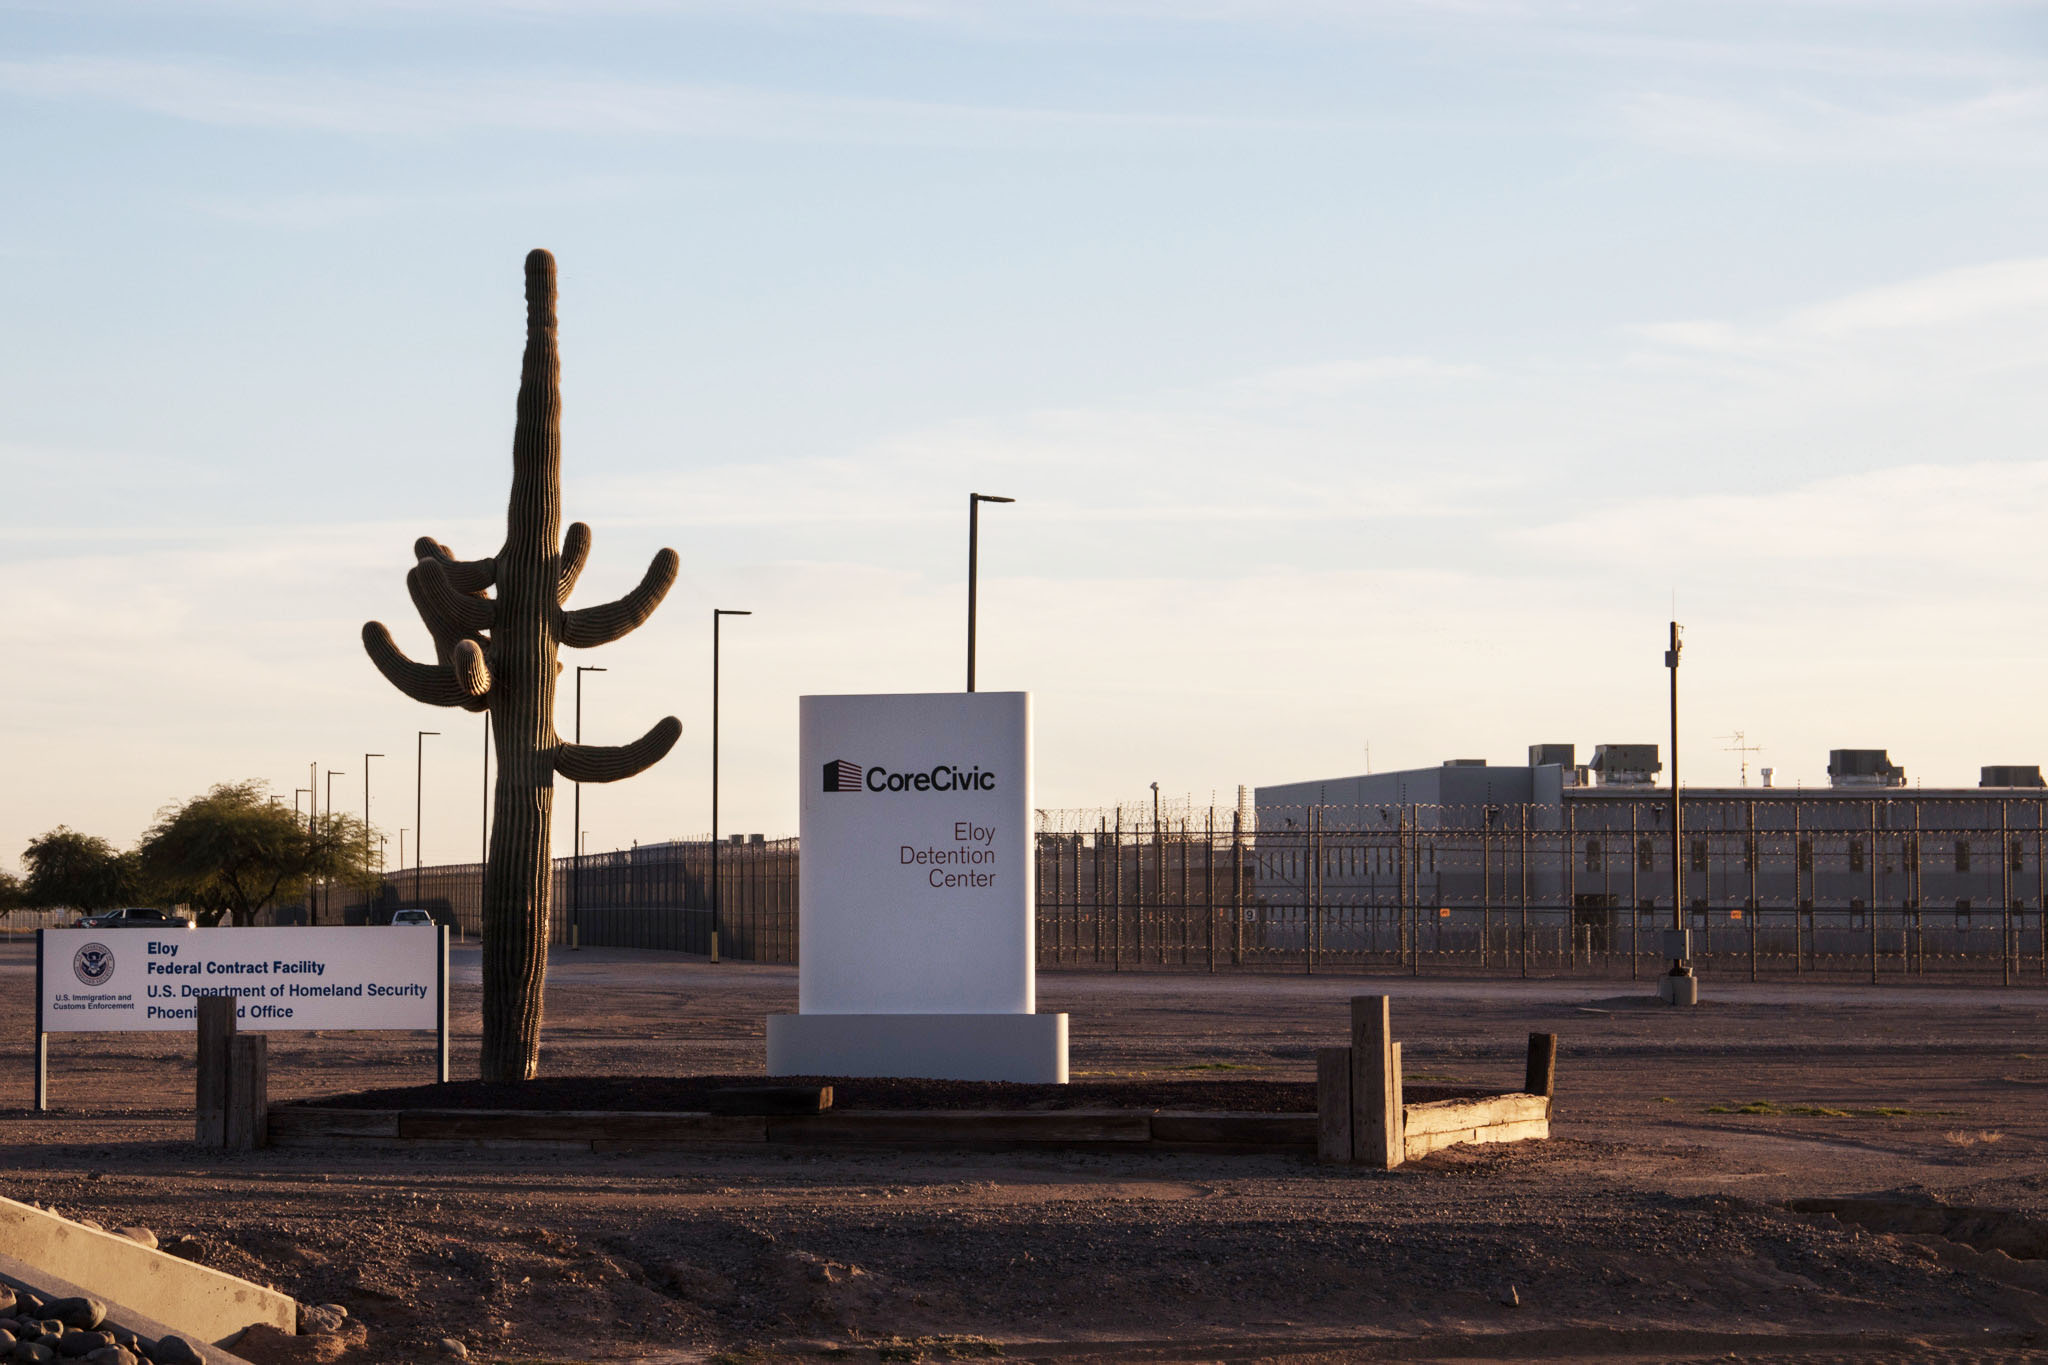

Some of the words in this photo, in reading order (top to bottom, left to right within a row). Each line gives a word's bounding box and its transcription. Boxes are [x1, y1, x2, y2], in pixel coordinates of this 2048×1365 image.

[866, 765, 996, 792] CoreCivic
[954, 821, 996, 846] Eloy
[900, 845, 995, 865] Detention
[929, 868, 996, 888] Center
[147, 942, 179, 956] Eloy
[147, 962, 202, 975] Federal
[206, 961, 269, 975] Contract
[272, 960, 326, 977] Facility
[55, 994, 71, 1002] U.S.
[72, 994, 116, 1004] Immigration
[117, 994, 132, 1002] and
[147, 985, 177, 998] U.S.
[181, 985, 266, 998] Department
[270, 984, 286, 997] of
[289, 983, 363, 997] Homeland
[367, 982, 428, 1000] Security
[53, 1002, 86, 1010] Customs
[87, 1002, 135, 1010] Enforcement
[147, 1006, 198, 1019] Phoeni
[250, 1005, 294, 1019] Office
